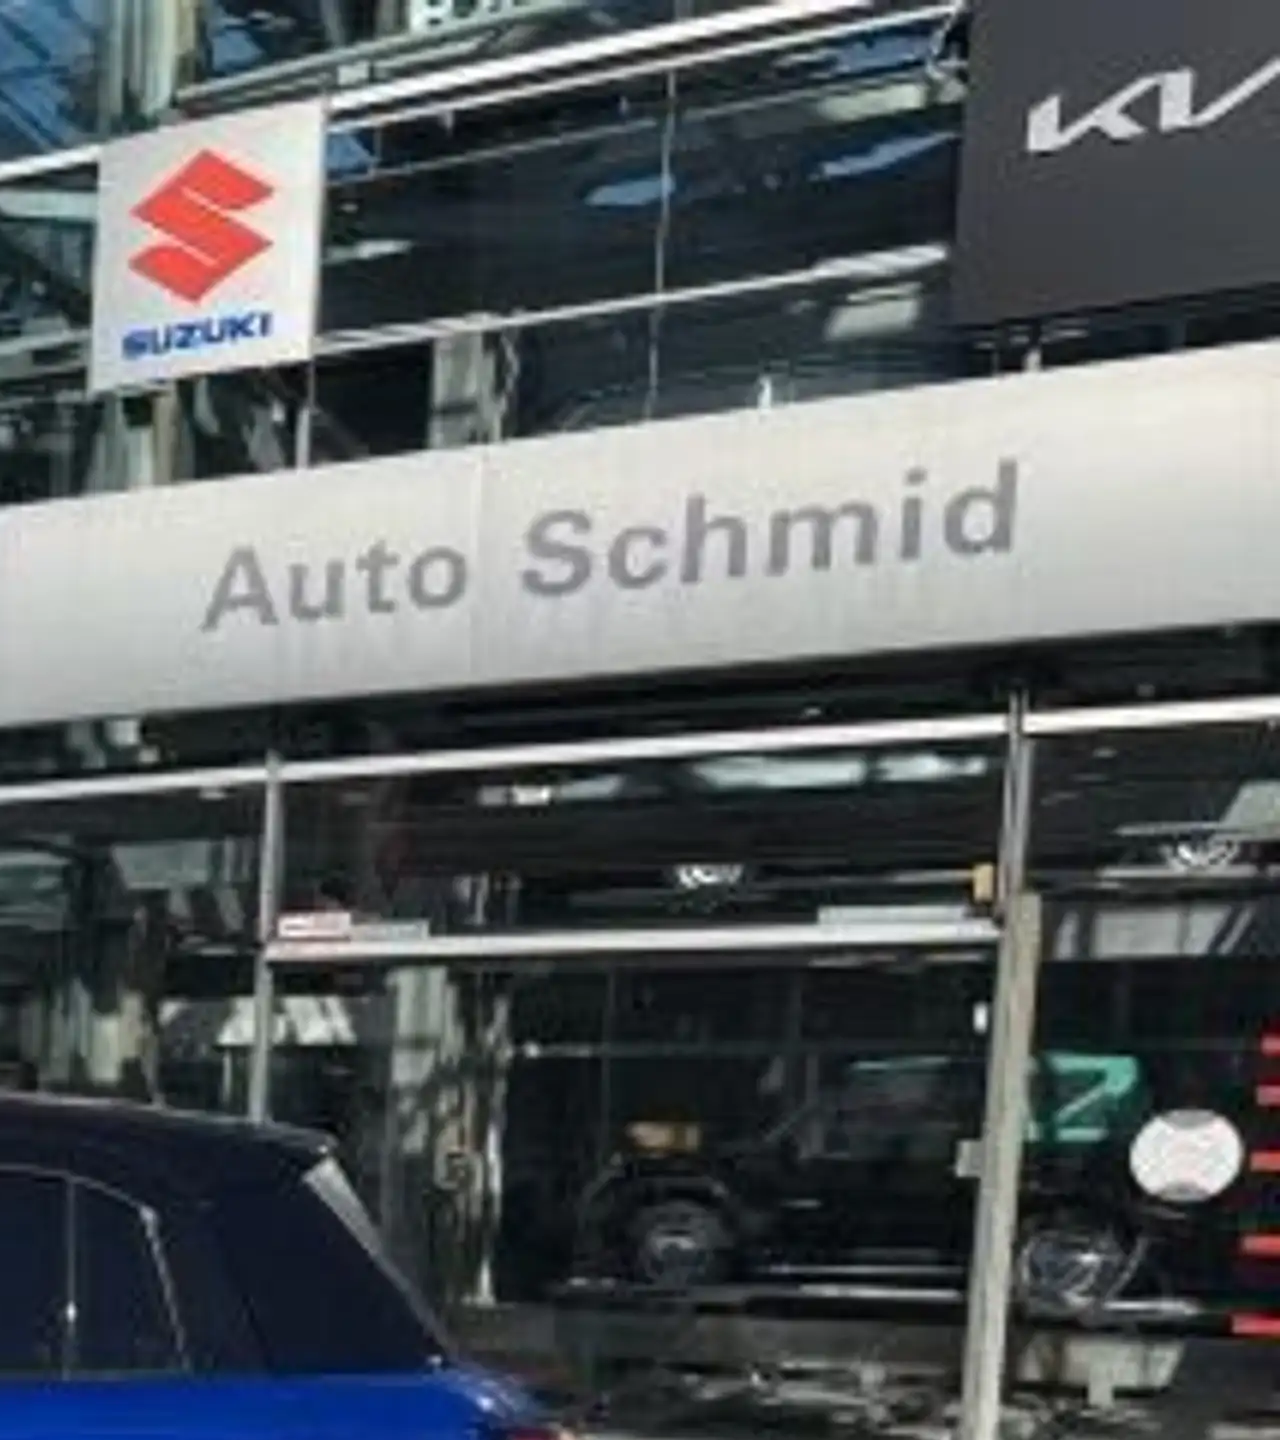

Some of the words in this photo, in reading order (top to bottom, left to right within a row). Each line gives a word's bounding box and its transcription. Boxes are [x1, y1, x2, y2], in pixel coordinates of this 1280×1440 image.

[122, 311, 274, 360] SUZUKI
[200, 536, 467, 632] Auto
[520, 457, 1020, 599] Schmid
